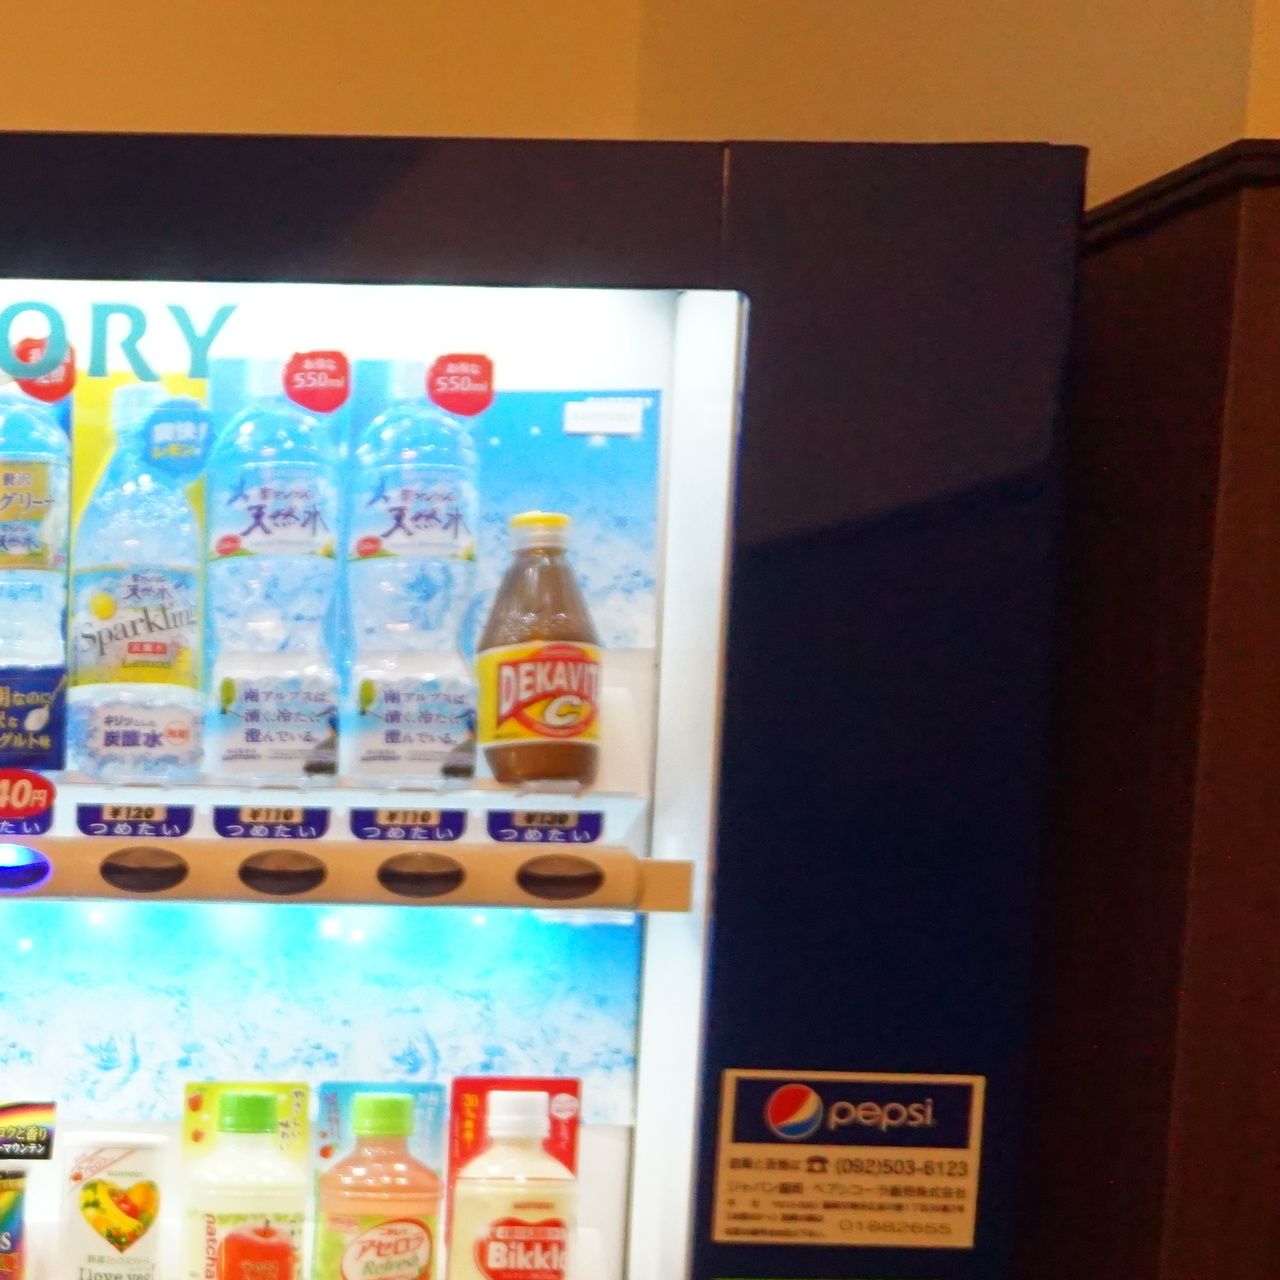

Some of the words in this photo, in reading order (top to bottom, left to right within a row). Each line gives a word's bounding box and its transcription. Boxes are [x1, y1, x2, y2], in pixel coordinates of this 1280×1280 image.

[241, 504, 329, 537] 天然水
[381, 505, 471, 539] 天然水
[543, 694, 582, 727] C
[103, 730, 163, 748] 炭酸水
[90, 822, 181, 836] つめたい
[226, 825, 317, 838] つめたい
[363, 826, 453, 839] つめたい
[499, 829, 590, 842] つめたい
[828, 1098, 934, 1133] pepsi
